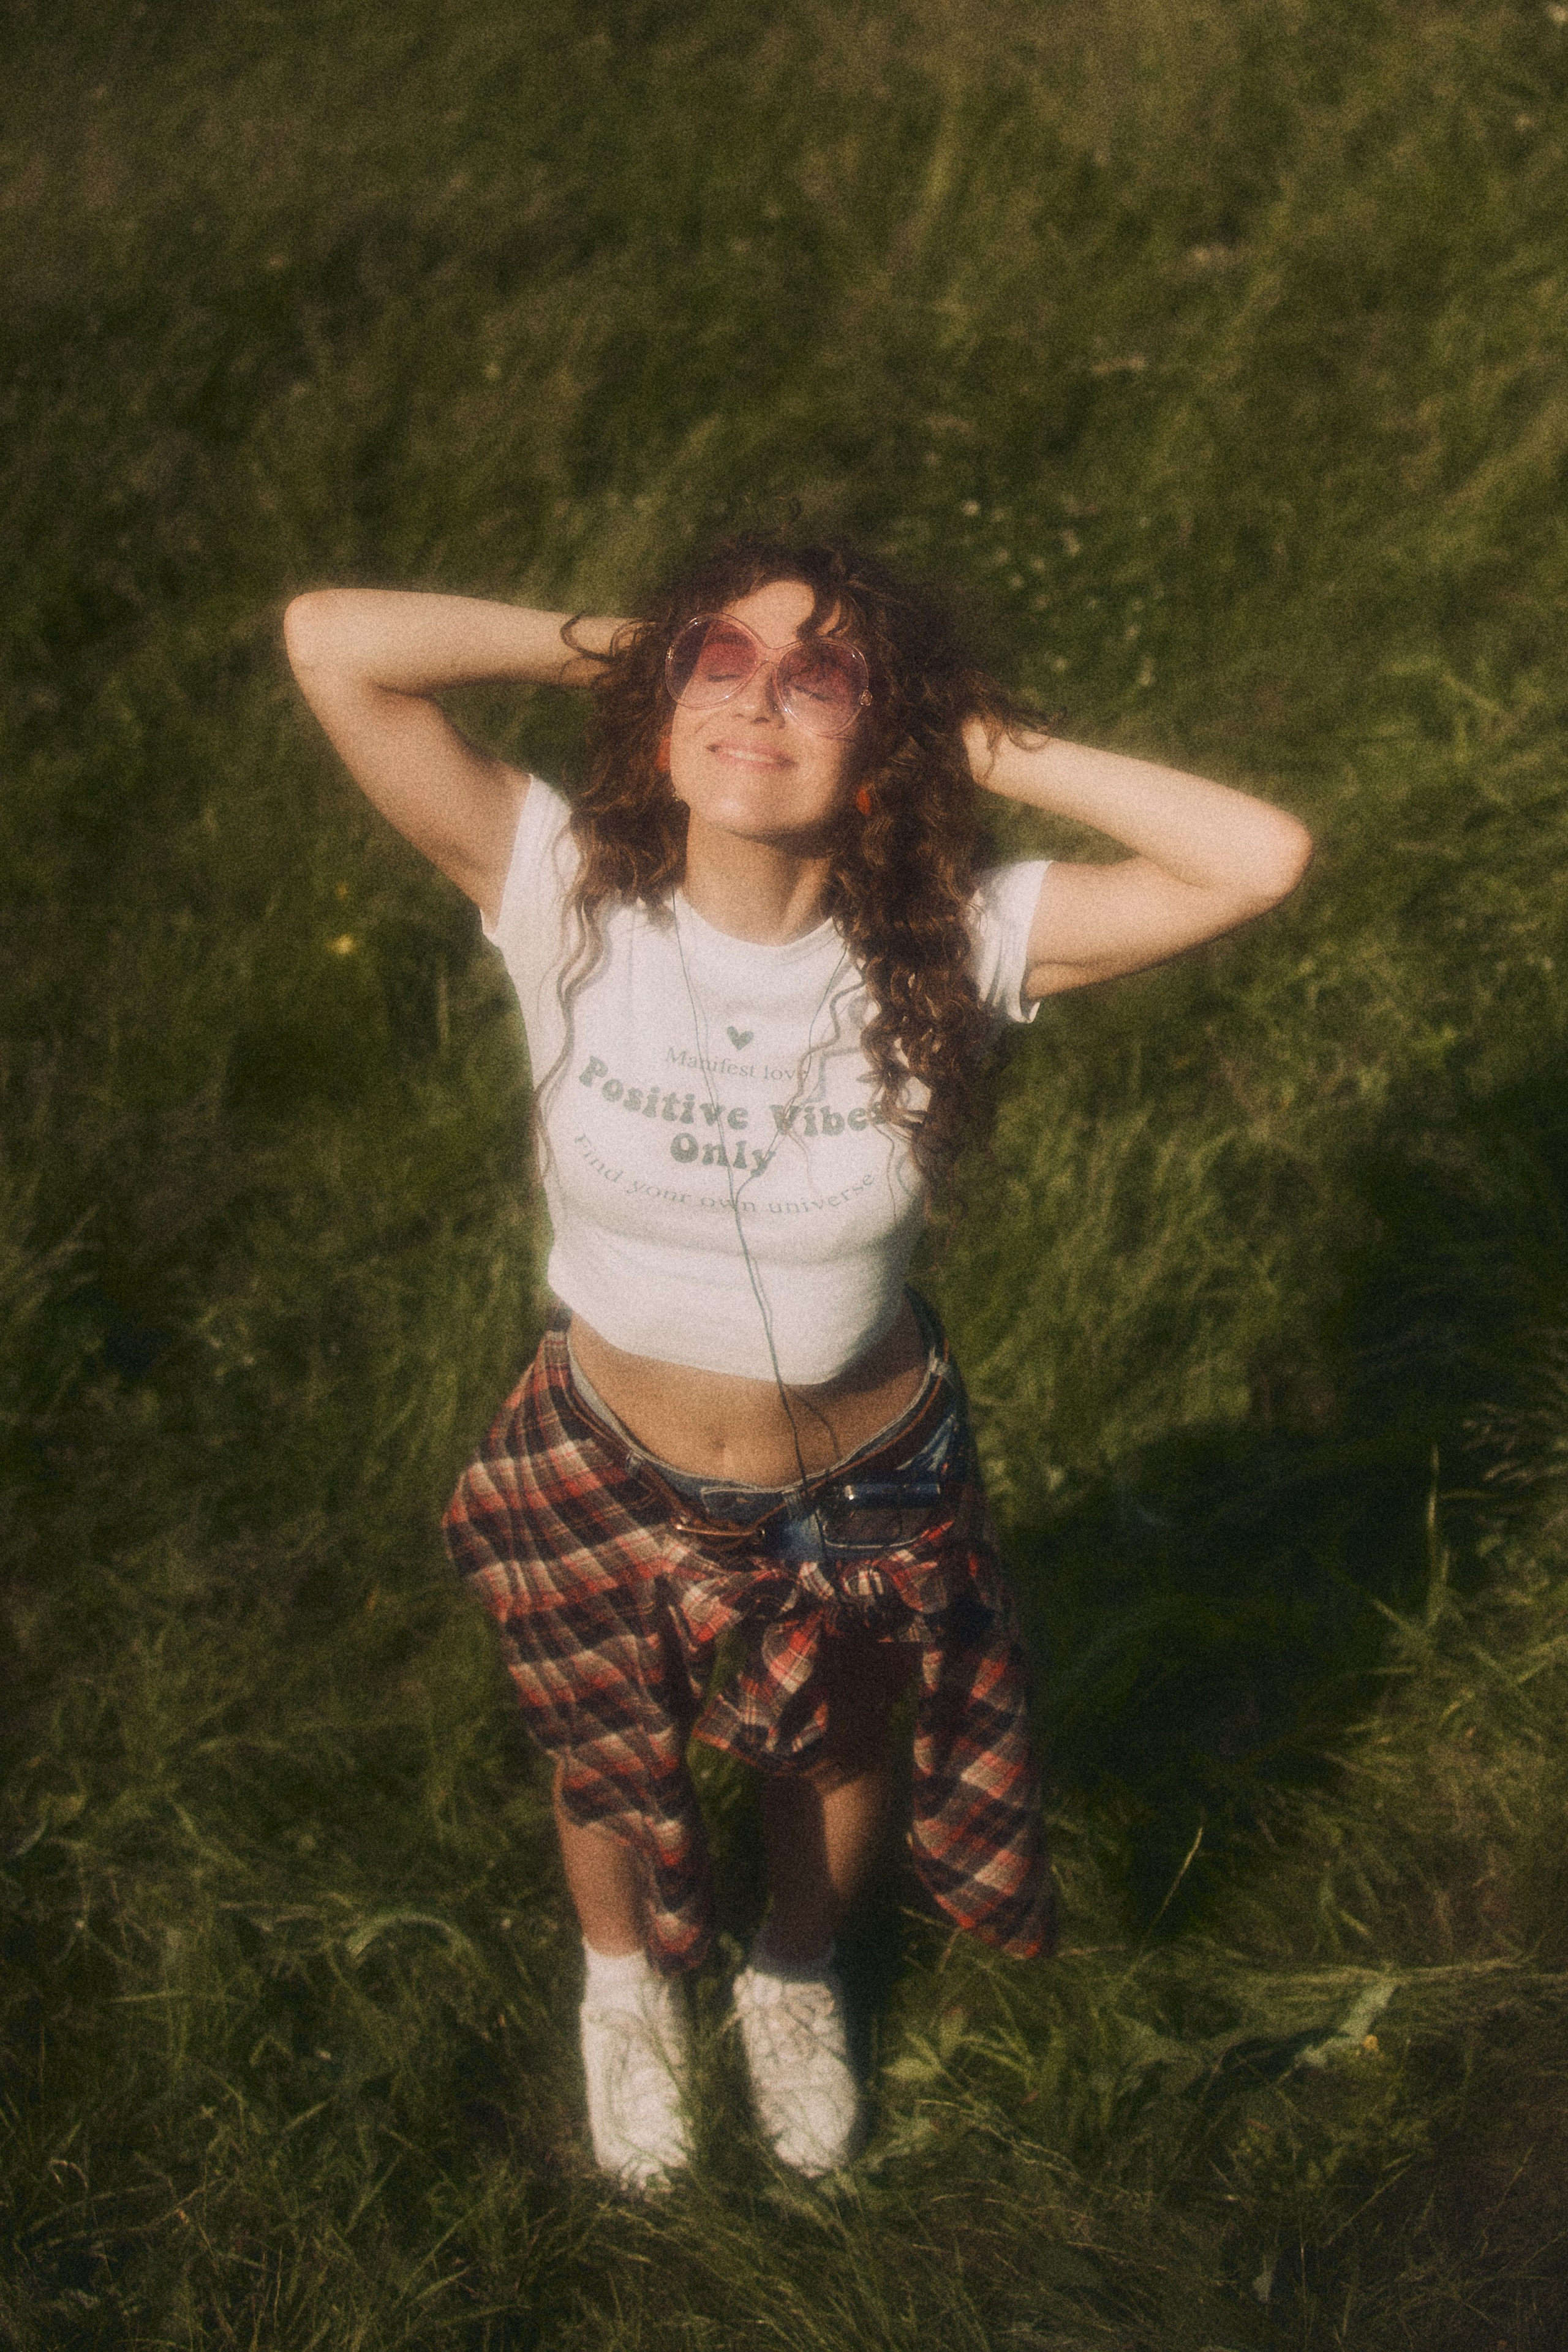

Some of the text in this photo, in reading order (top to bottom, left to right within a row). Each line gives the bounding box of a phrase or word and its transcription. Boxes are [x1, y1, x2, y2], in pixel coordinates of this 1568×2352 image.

[665, 1046, 755, 1077] Manifest
[579, 1055, 748, 1130] Positive
[574, 1133, 875, 1214] Find your own universe
[670, 1133, 776, 1177] Only
